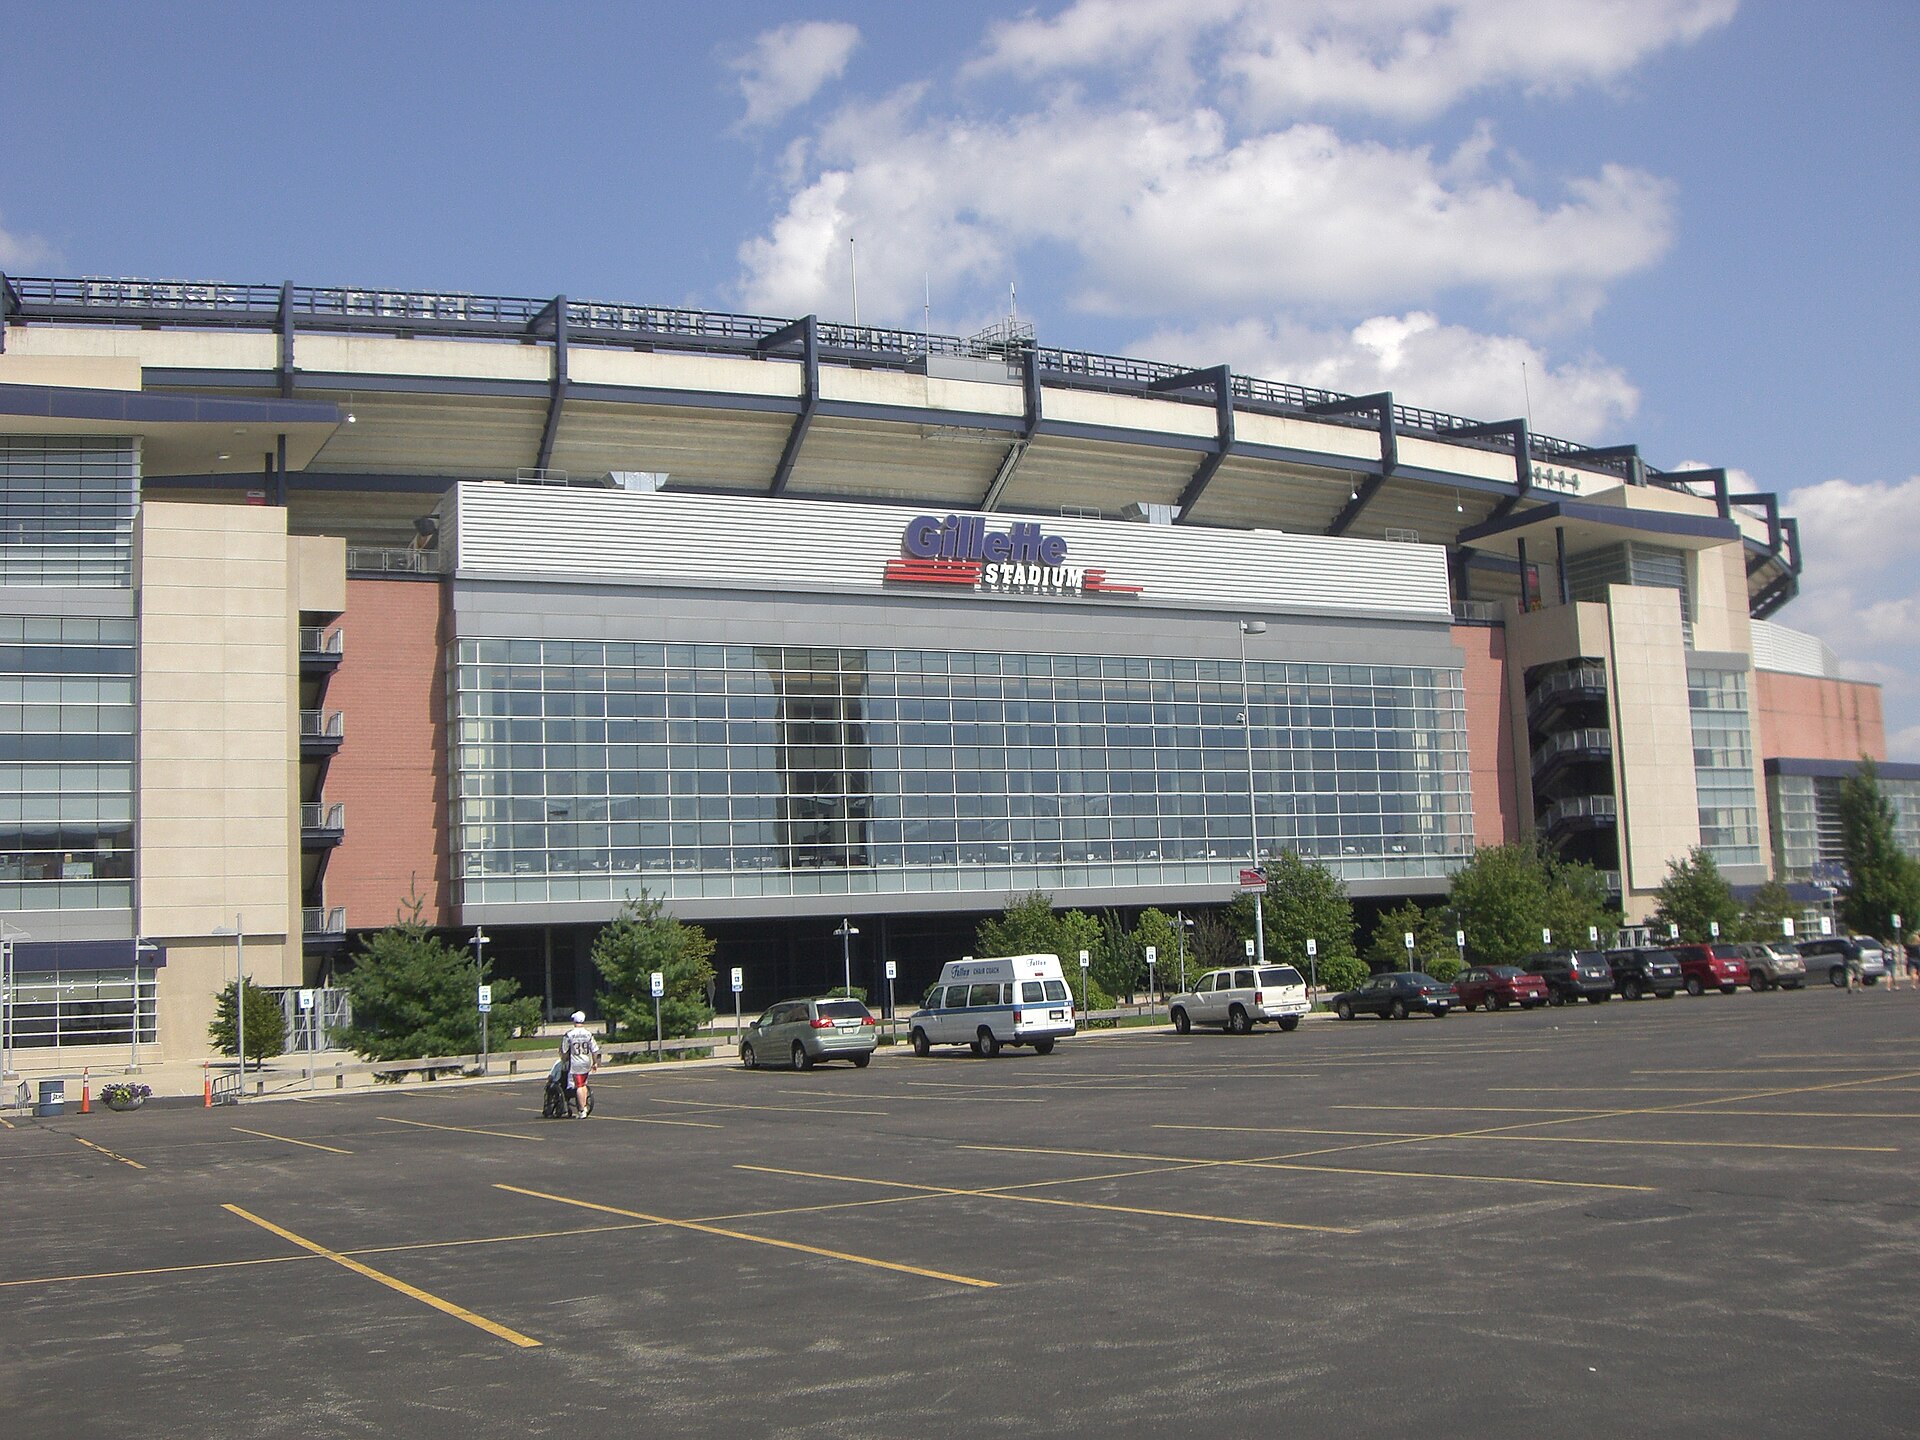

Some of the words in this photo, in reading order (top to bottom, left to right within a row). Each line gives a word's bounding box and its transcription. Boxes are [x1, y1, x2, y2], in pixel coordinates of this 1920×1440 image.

[903, 514, 1068, 565] Gillette
[985, 563, 1083, 588] STADIUM
[573, 1041, 590, 1056] 39
